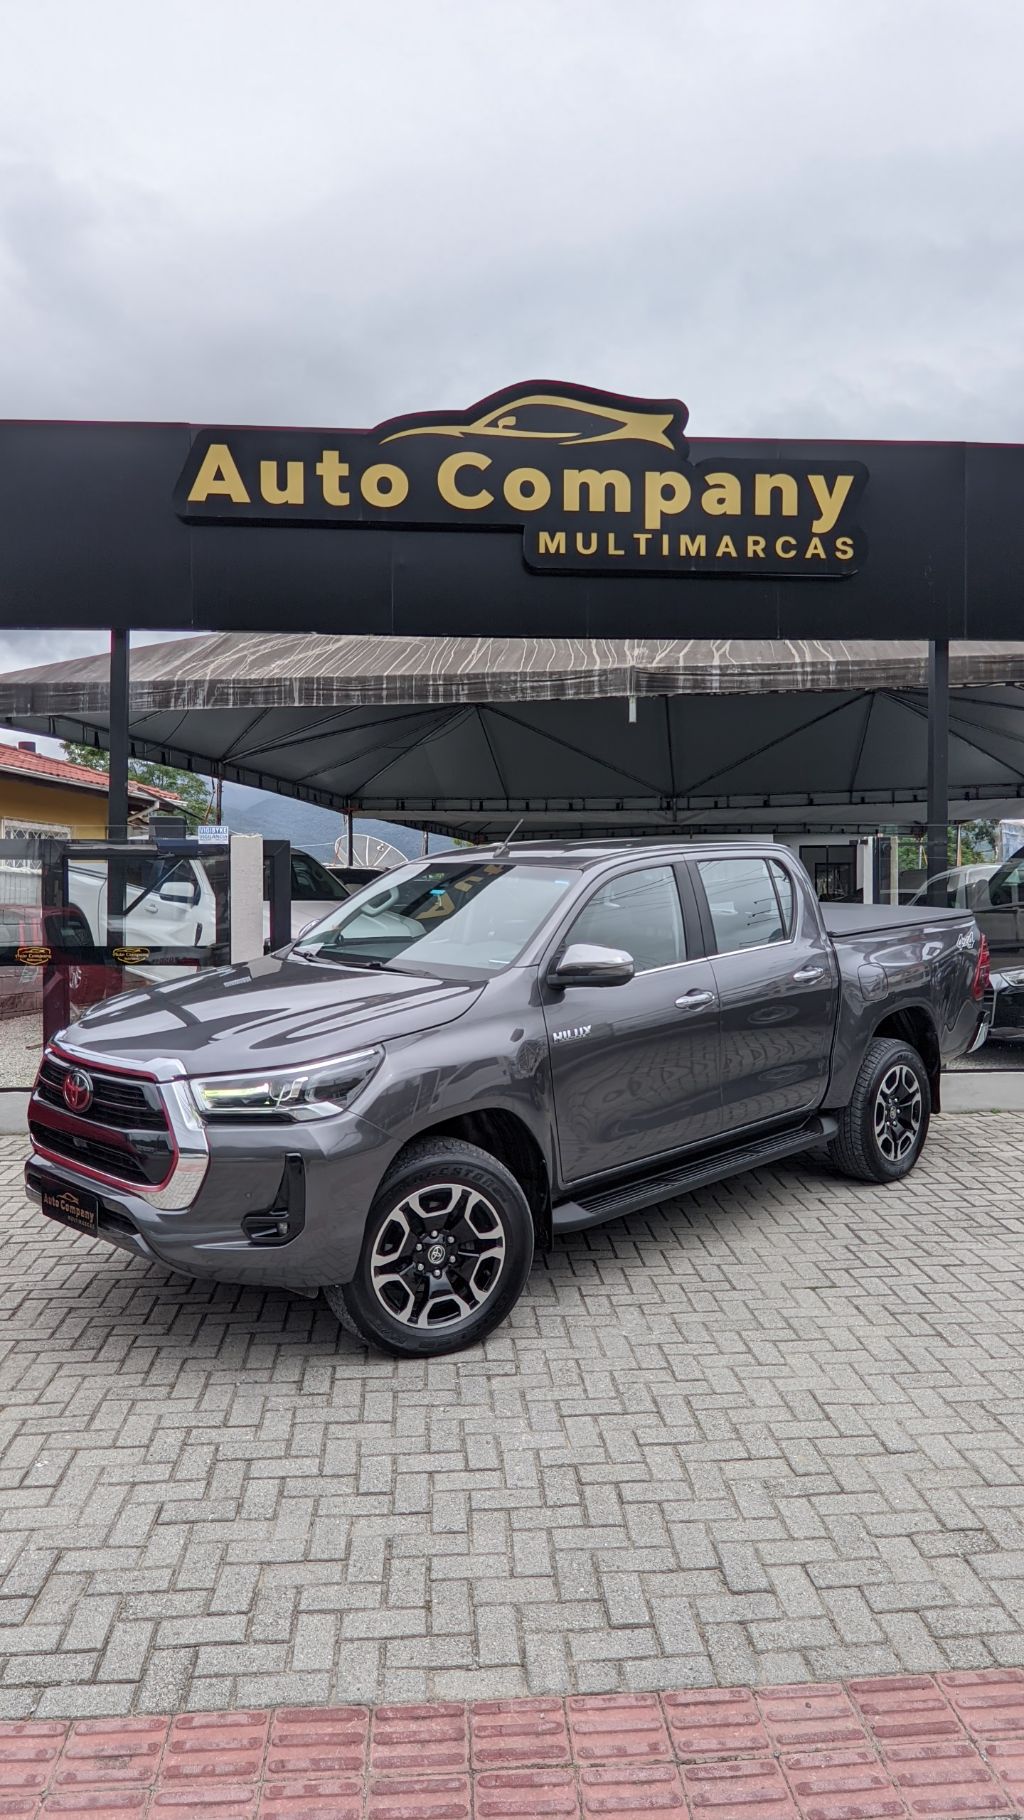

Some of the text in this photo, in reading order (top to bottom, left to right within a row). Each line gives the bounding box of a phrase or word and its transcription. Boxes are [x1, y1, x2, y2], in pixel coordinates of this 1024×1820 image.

[187, 443, 855, 534] Auto Company
[538, 531, 855, 560] MULTIMARCAS
[552, 1024, 592, 1040] HILUX
[44, 1193, 95, 1223] Auto Company
